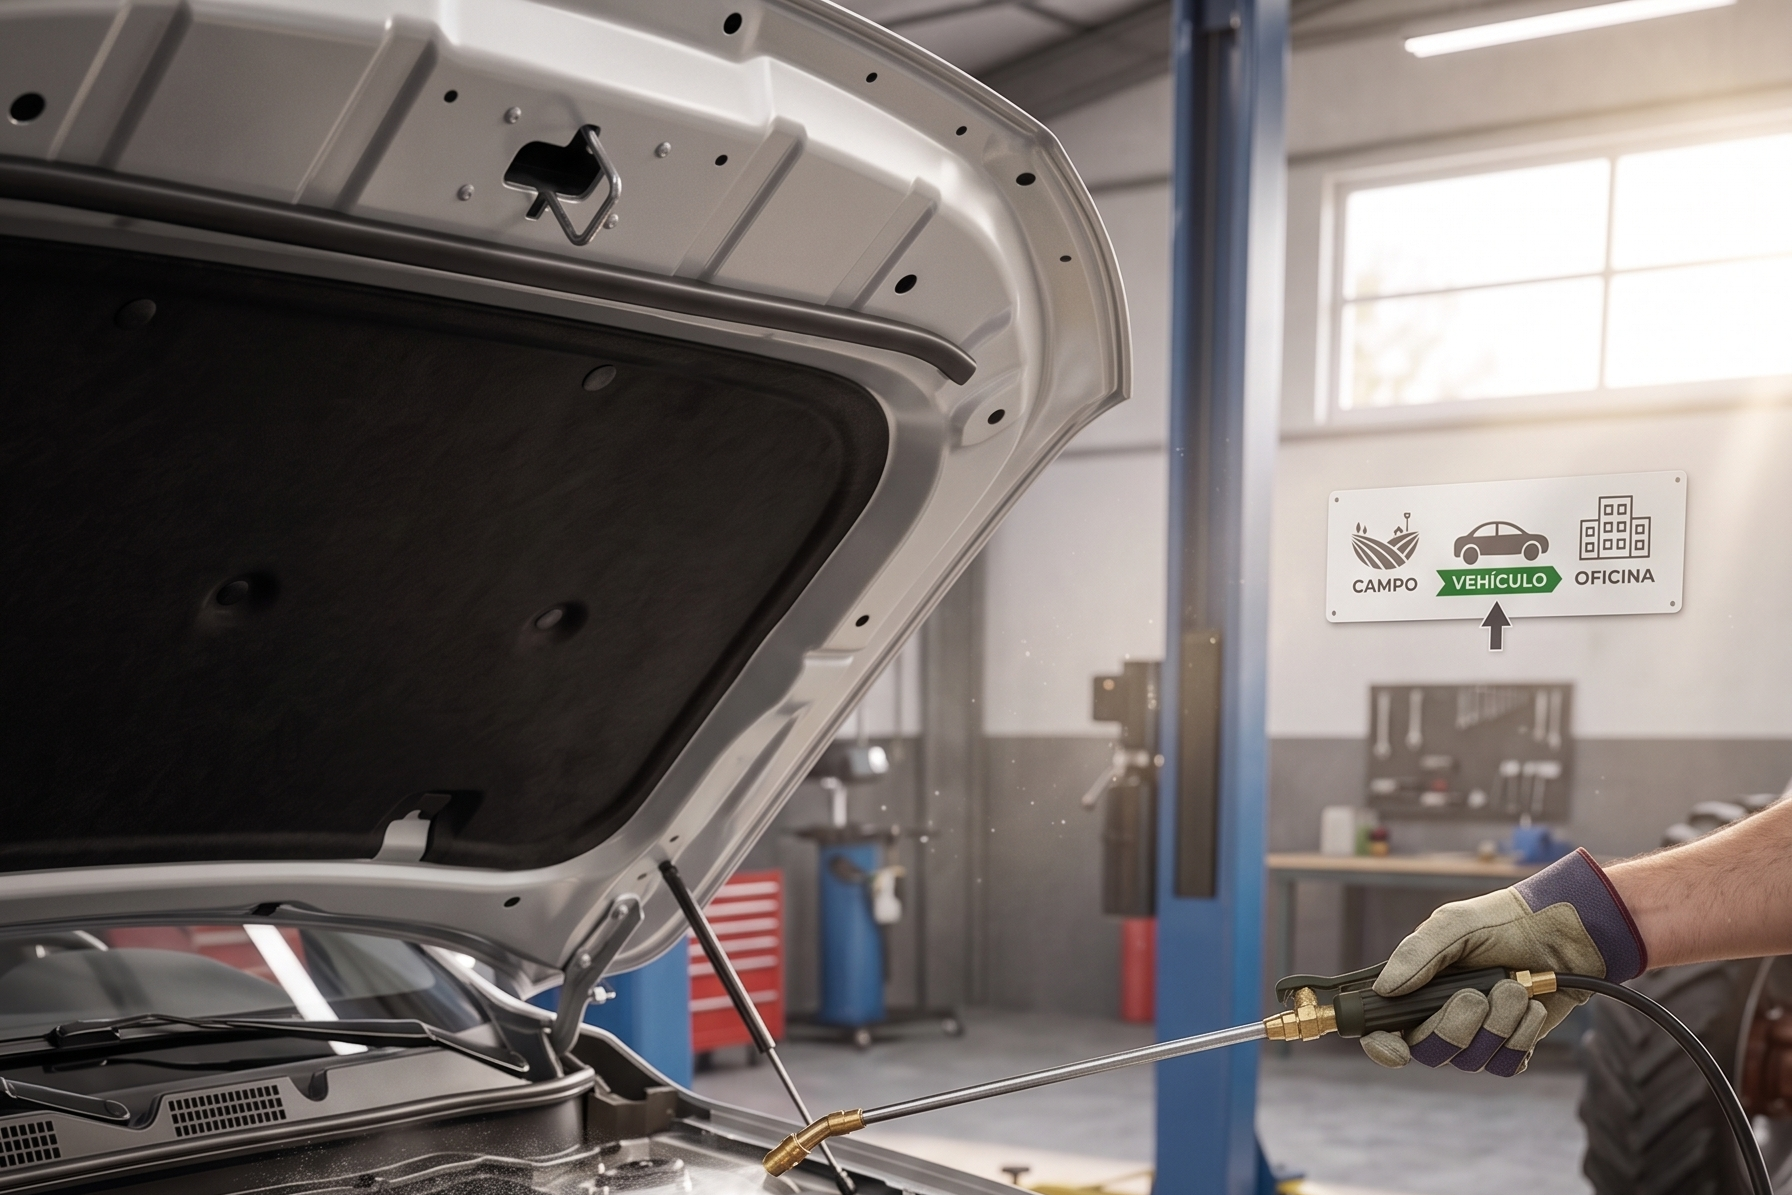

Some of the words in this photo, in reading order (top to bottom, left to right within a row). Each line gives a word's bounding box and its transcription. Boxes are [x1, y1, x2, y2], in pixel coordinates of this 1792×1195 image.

[1352, 577, 1419, 593] CAMPO
[1452, 571, 1547, 591] VEHÍCULO
[1574, 568, 1655, 586] OFICINA
